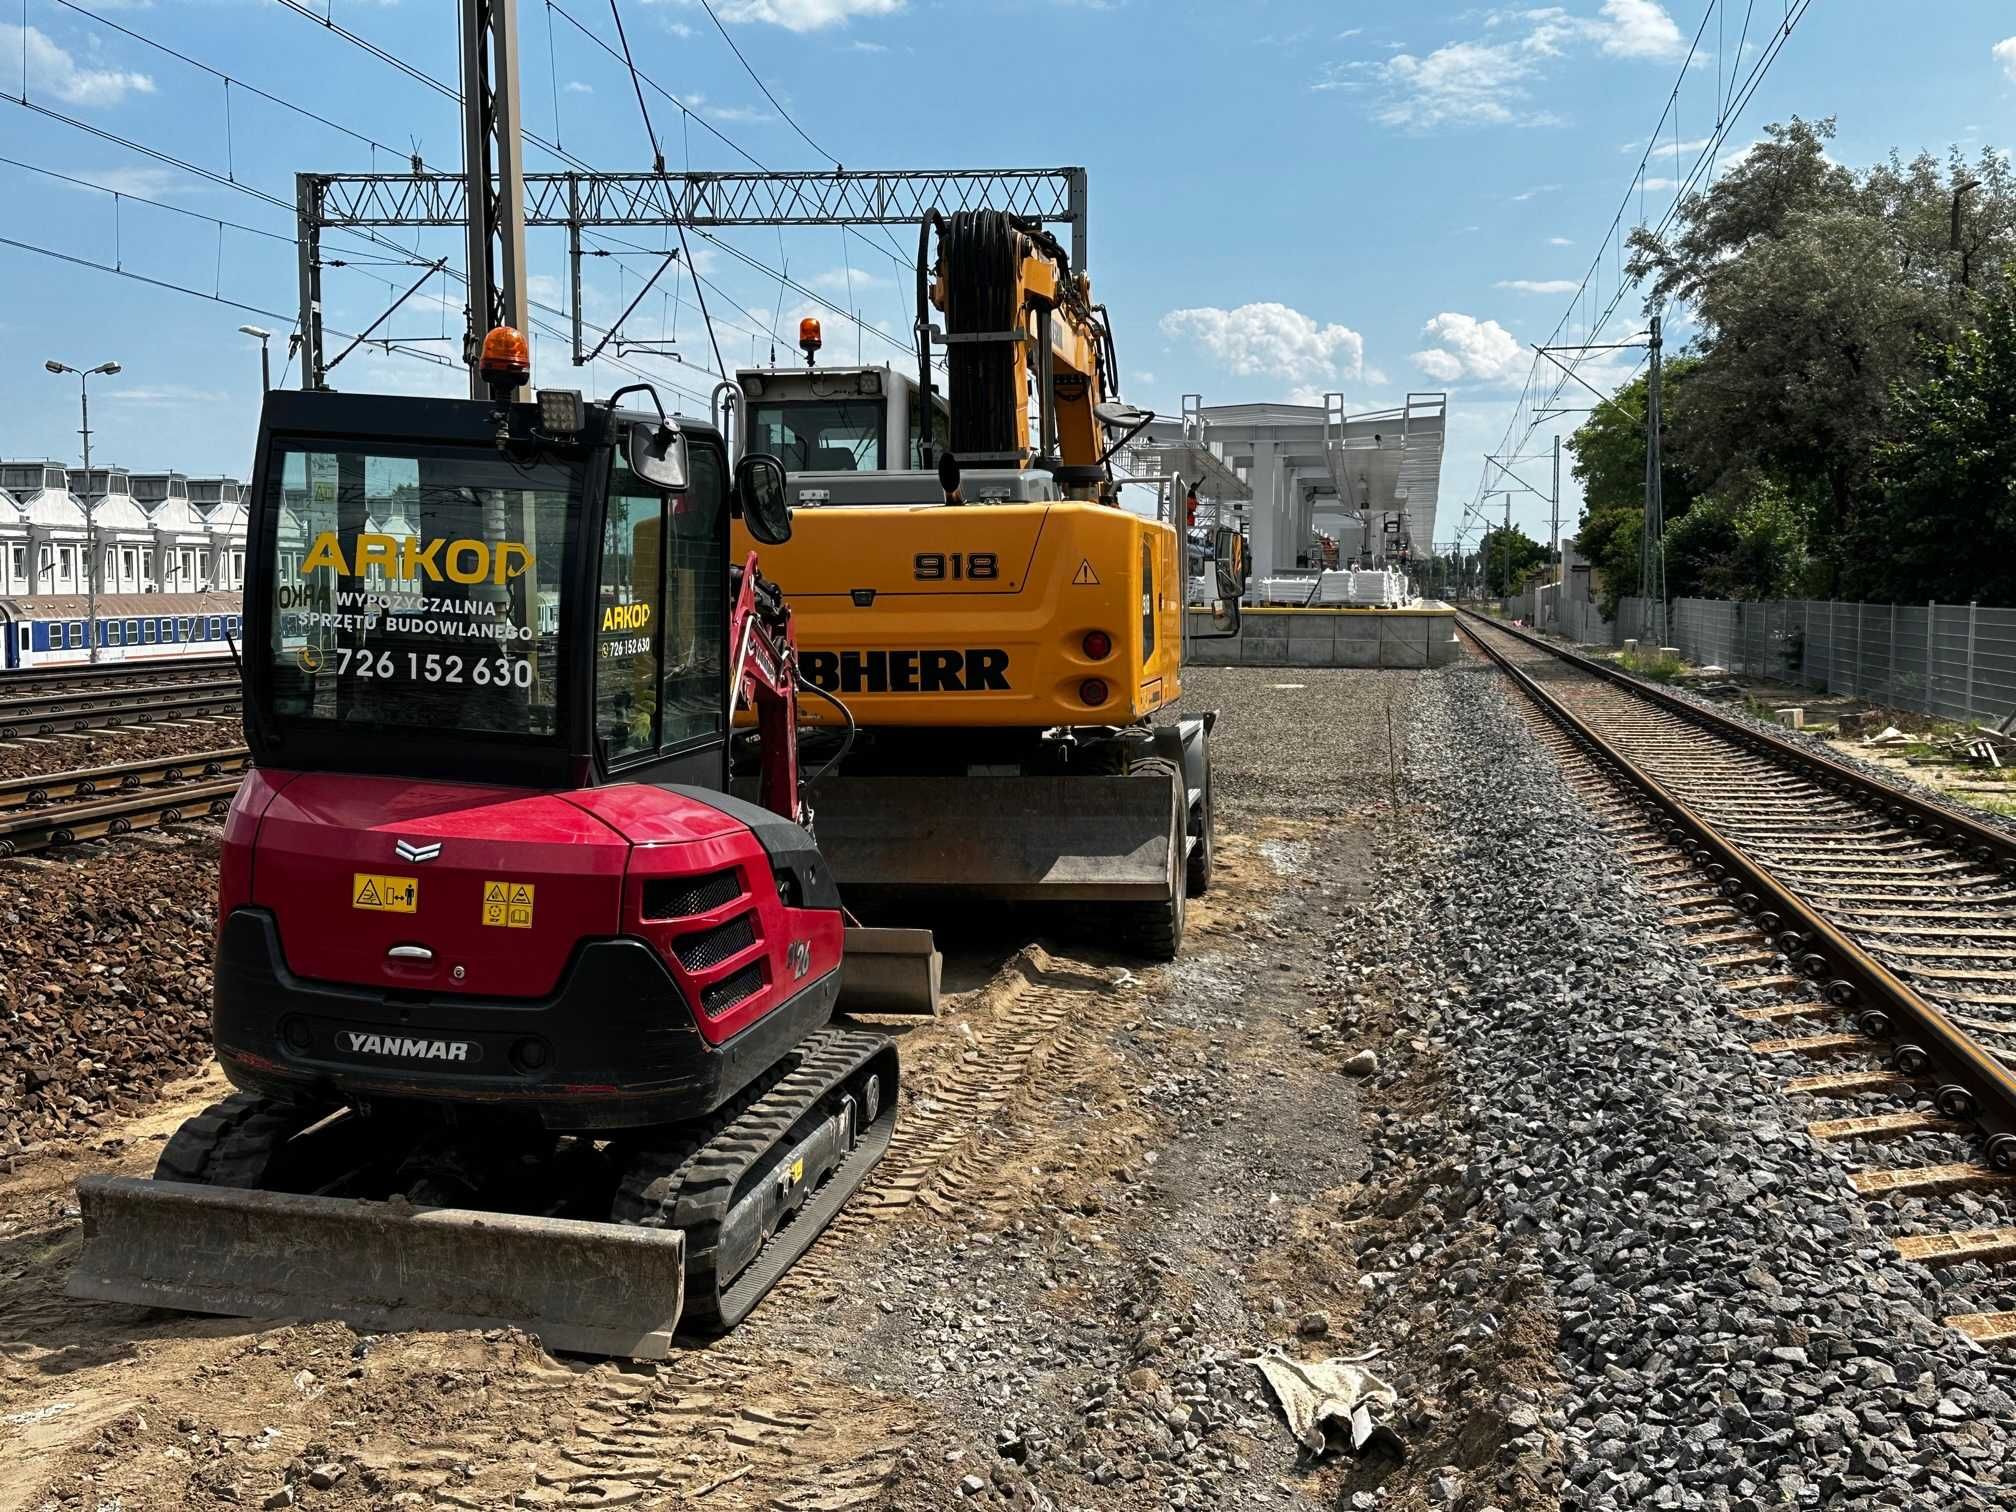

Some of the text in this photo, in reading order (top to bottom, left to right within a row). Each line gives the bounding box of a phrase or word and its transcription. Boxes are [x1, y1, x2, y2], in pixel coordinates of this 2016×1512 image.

[301, 531, 535, 585] ARKOP
[912, 552, 999, 582] 918
[335, 591, 497, 617] WYPOŻYCZALNIA
[602, 604, 650, 631] ARKOP
[298, 612, 533, 641] SPRZĘTU BUDOWLANEGO
[610, 637, 650, 657] 726 152 630
[336, 648, 533, 689] 726 152 630
[798, 648, 1012, 693] BHERR
[348, 1033, 468, 1061] YANMAR
